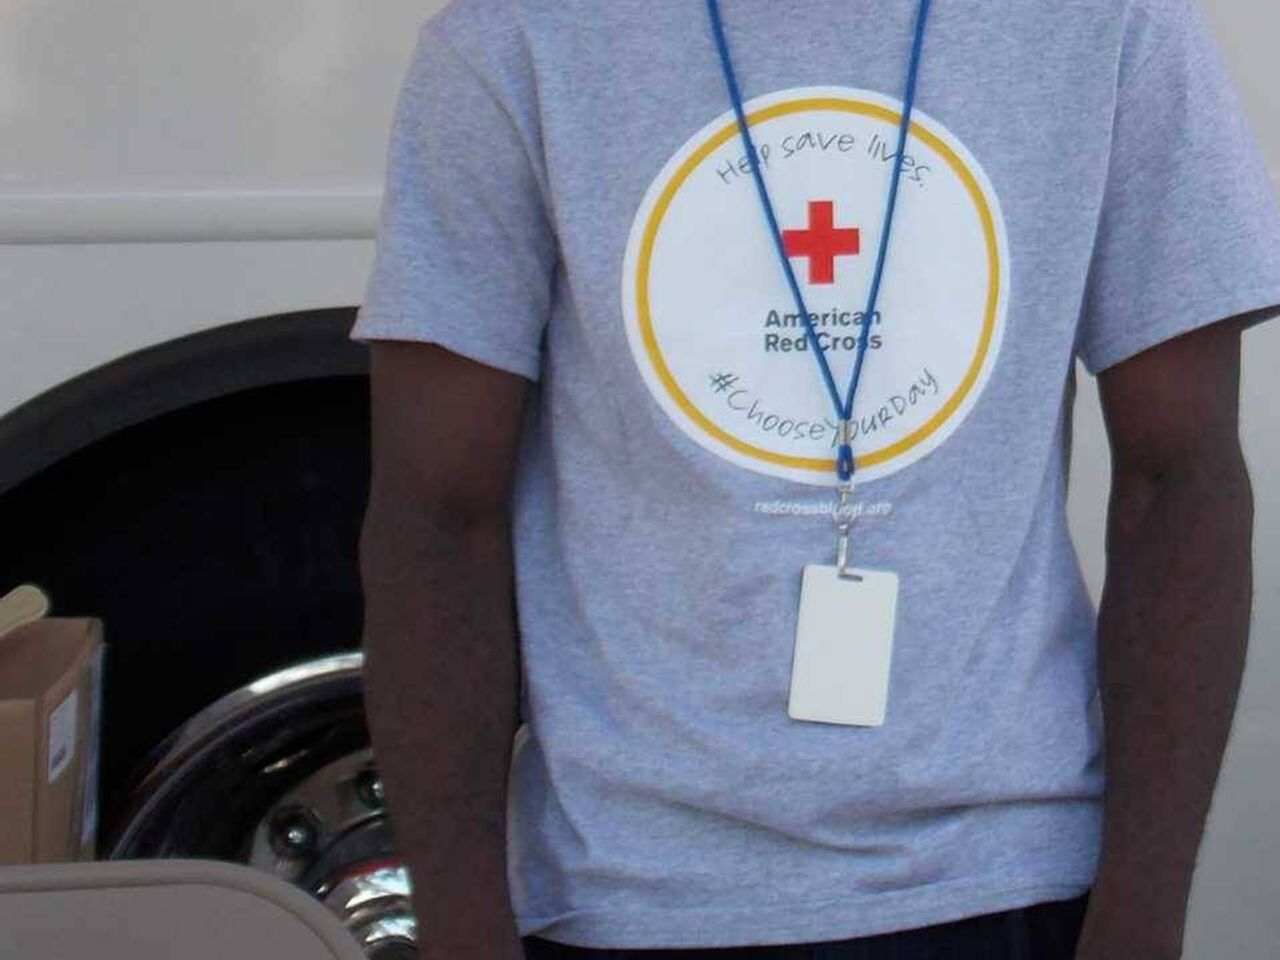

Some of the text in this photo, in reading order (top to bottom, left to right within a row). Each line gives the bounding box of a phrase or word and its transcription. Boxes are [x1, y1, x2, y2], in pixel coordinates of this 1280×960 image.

[716, 143, 770, 185] Hep
[781, 131, 855, 159] save
[765, 331, 883, 353] Red Cros
